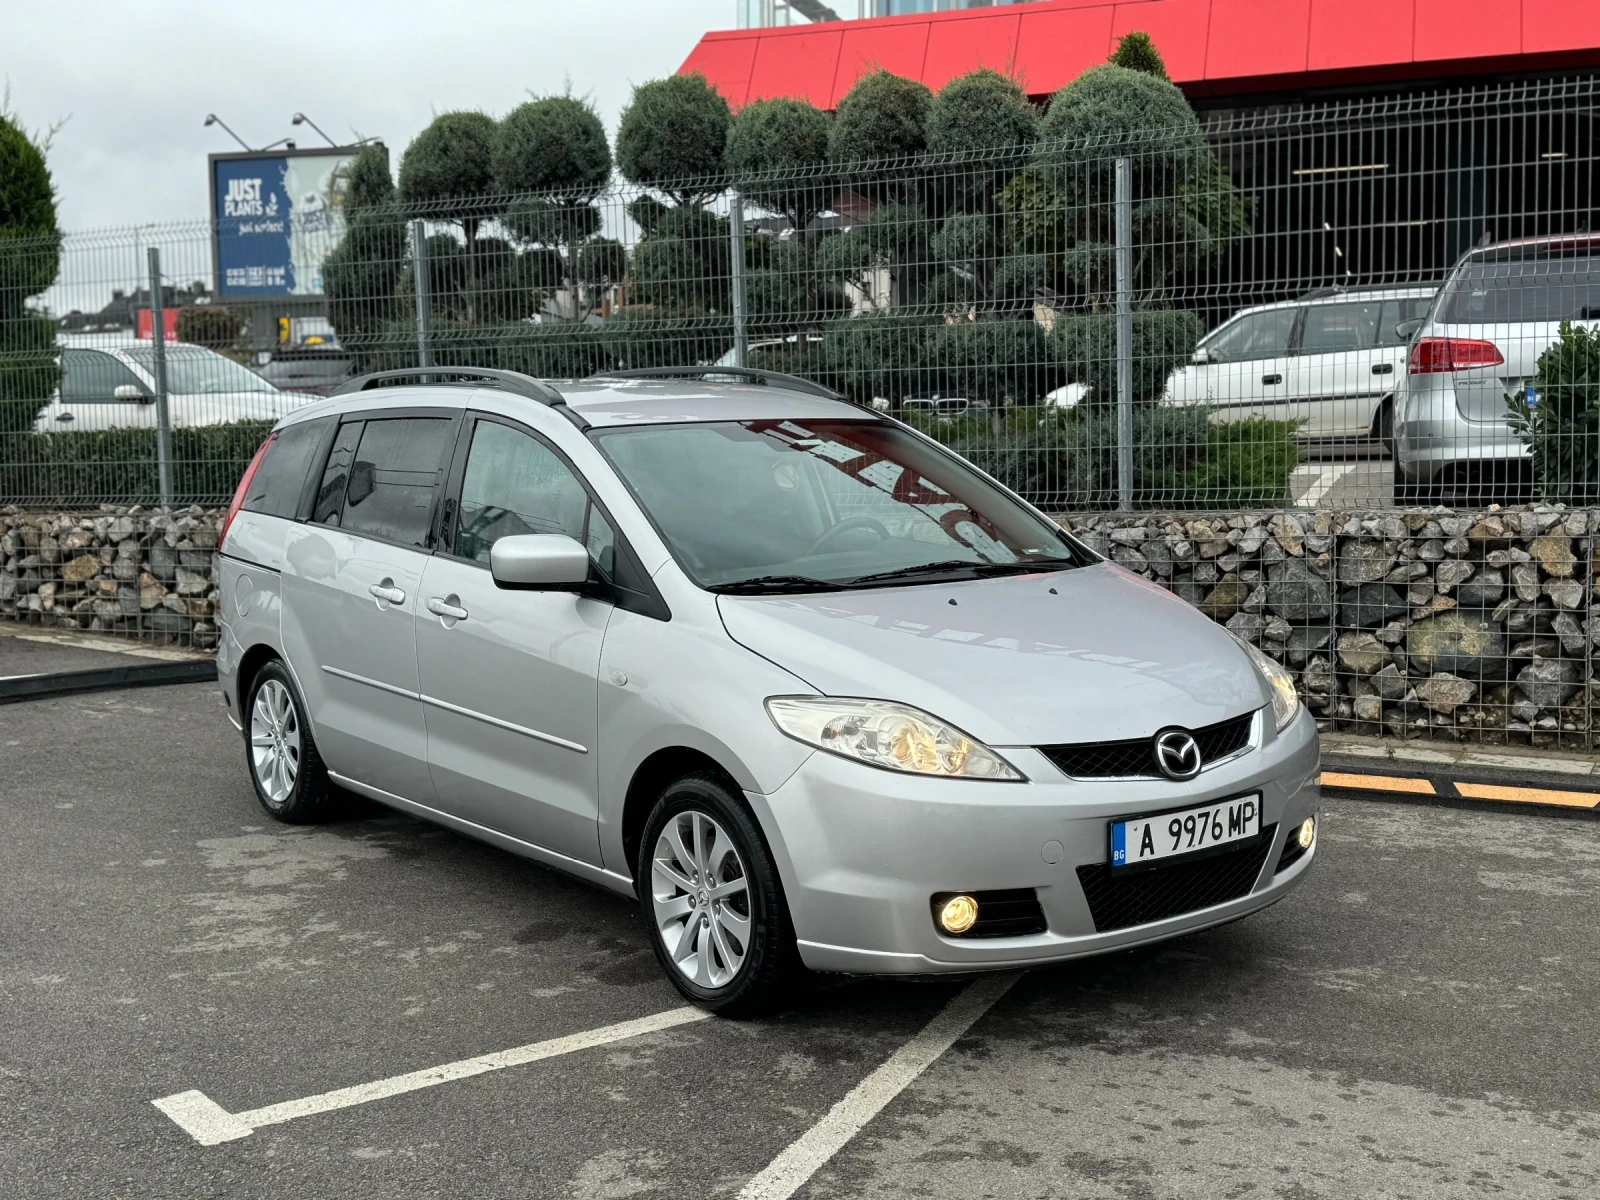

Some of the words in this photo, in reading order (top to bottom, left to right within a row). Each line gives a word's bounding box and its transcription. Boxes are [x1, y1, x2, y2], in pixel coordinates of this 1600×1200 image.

[224, 178, 262, 201] JUST
[224, 200, 263, 216] PLANTS
[1139, 823, 1155, 857] A
[1168, 809, 1222, 851] 9976
[1228, 801, 1256, 838] MP
[1113, 850, 1125, 861] BG
